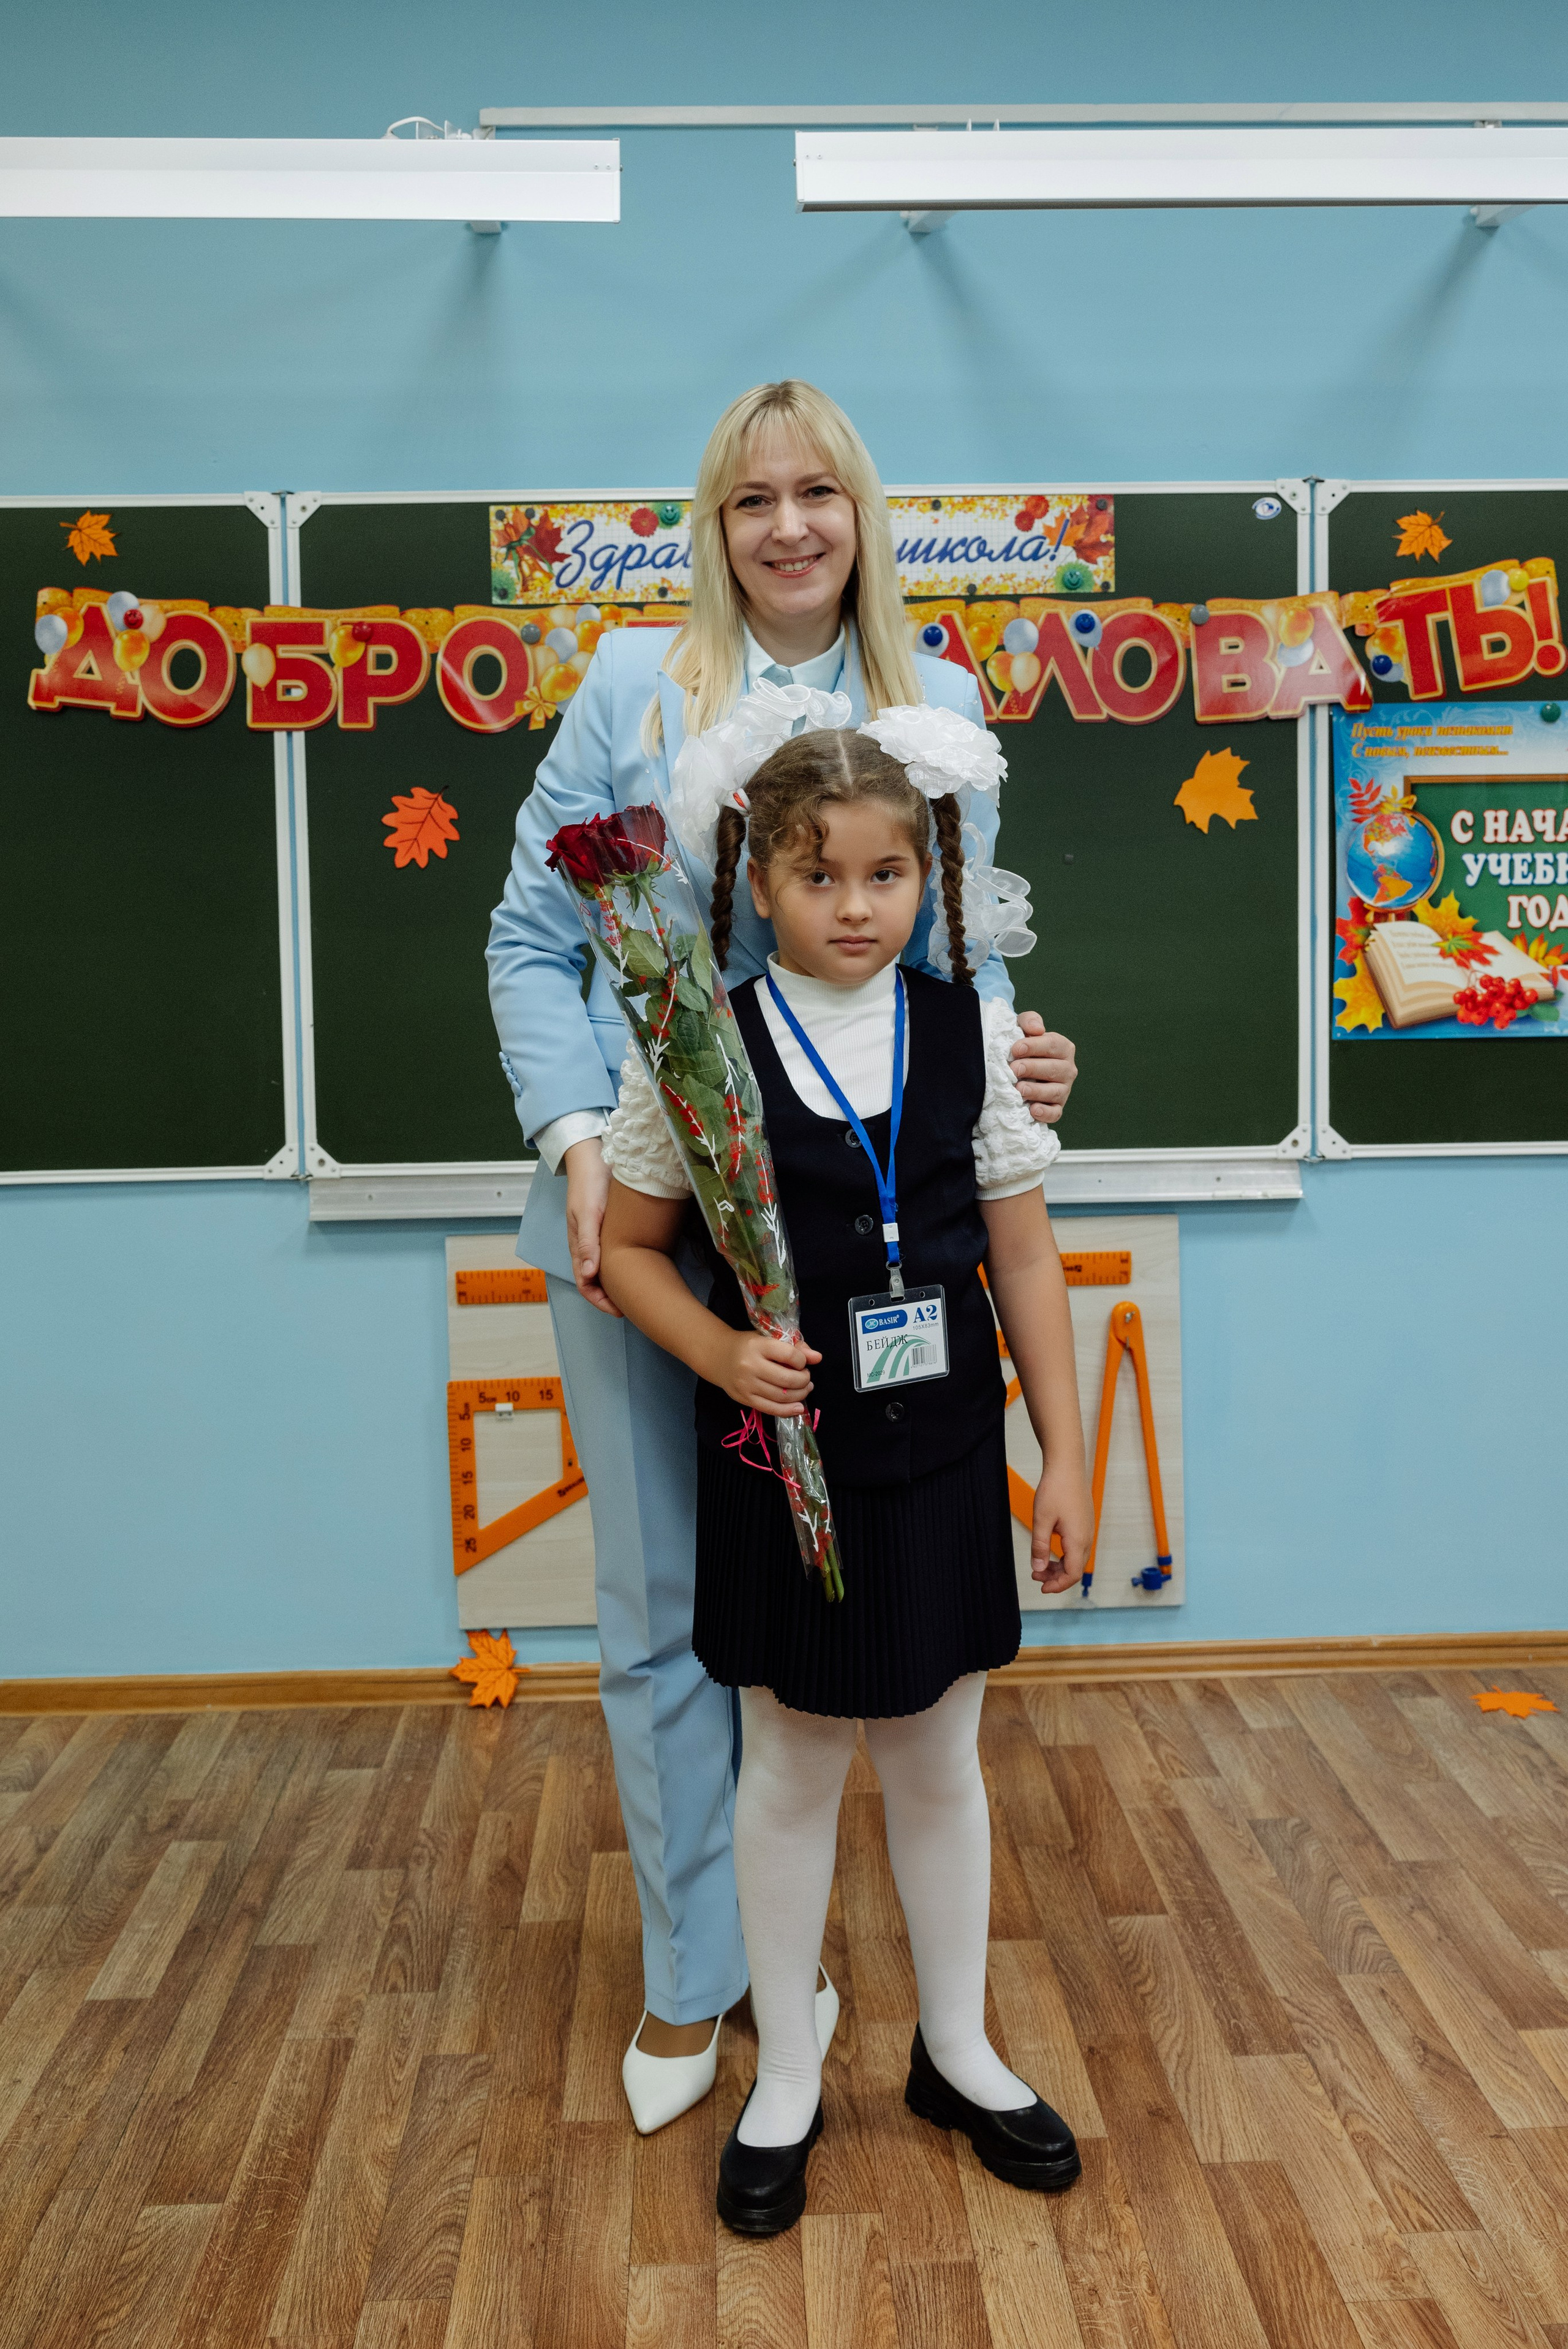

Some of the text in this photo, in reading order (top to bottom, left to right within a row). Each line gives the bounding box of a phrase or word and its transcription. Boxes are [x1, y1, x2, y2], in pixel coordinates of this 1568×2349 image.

[895, 518, 1068, 564] школа!
[28, 601, 535, 733] ДОБРО
[1351, 723, 1393, 741] Пусть
[1395, 726, 1433, 741] уроки
[1351, 743, 1363, 758] С
[1450, 809, 1474, 844] С
[913, 1305, 938, 1323] A2
[866, 1334, 908, 1351] БЕЙДЖ
[507, 1390, 521, 1402] 10
[539, 1389, 554, 1401] 15
[460, 1437, 472, 1452] 10
[461, 1471, 473, 1485] 15
